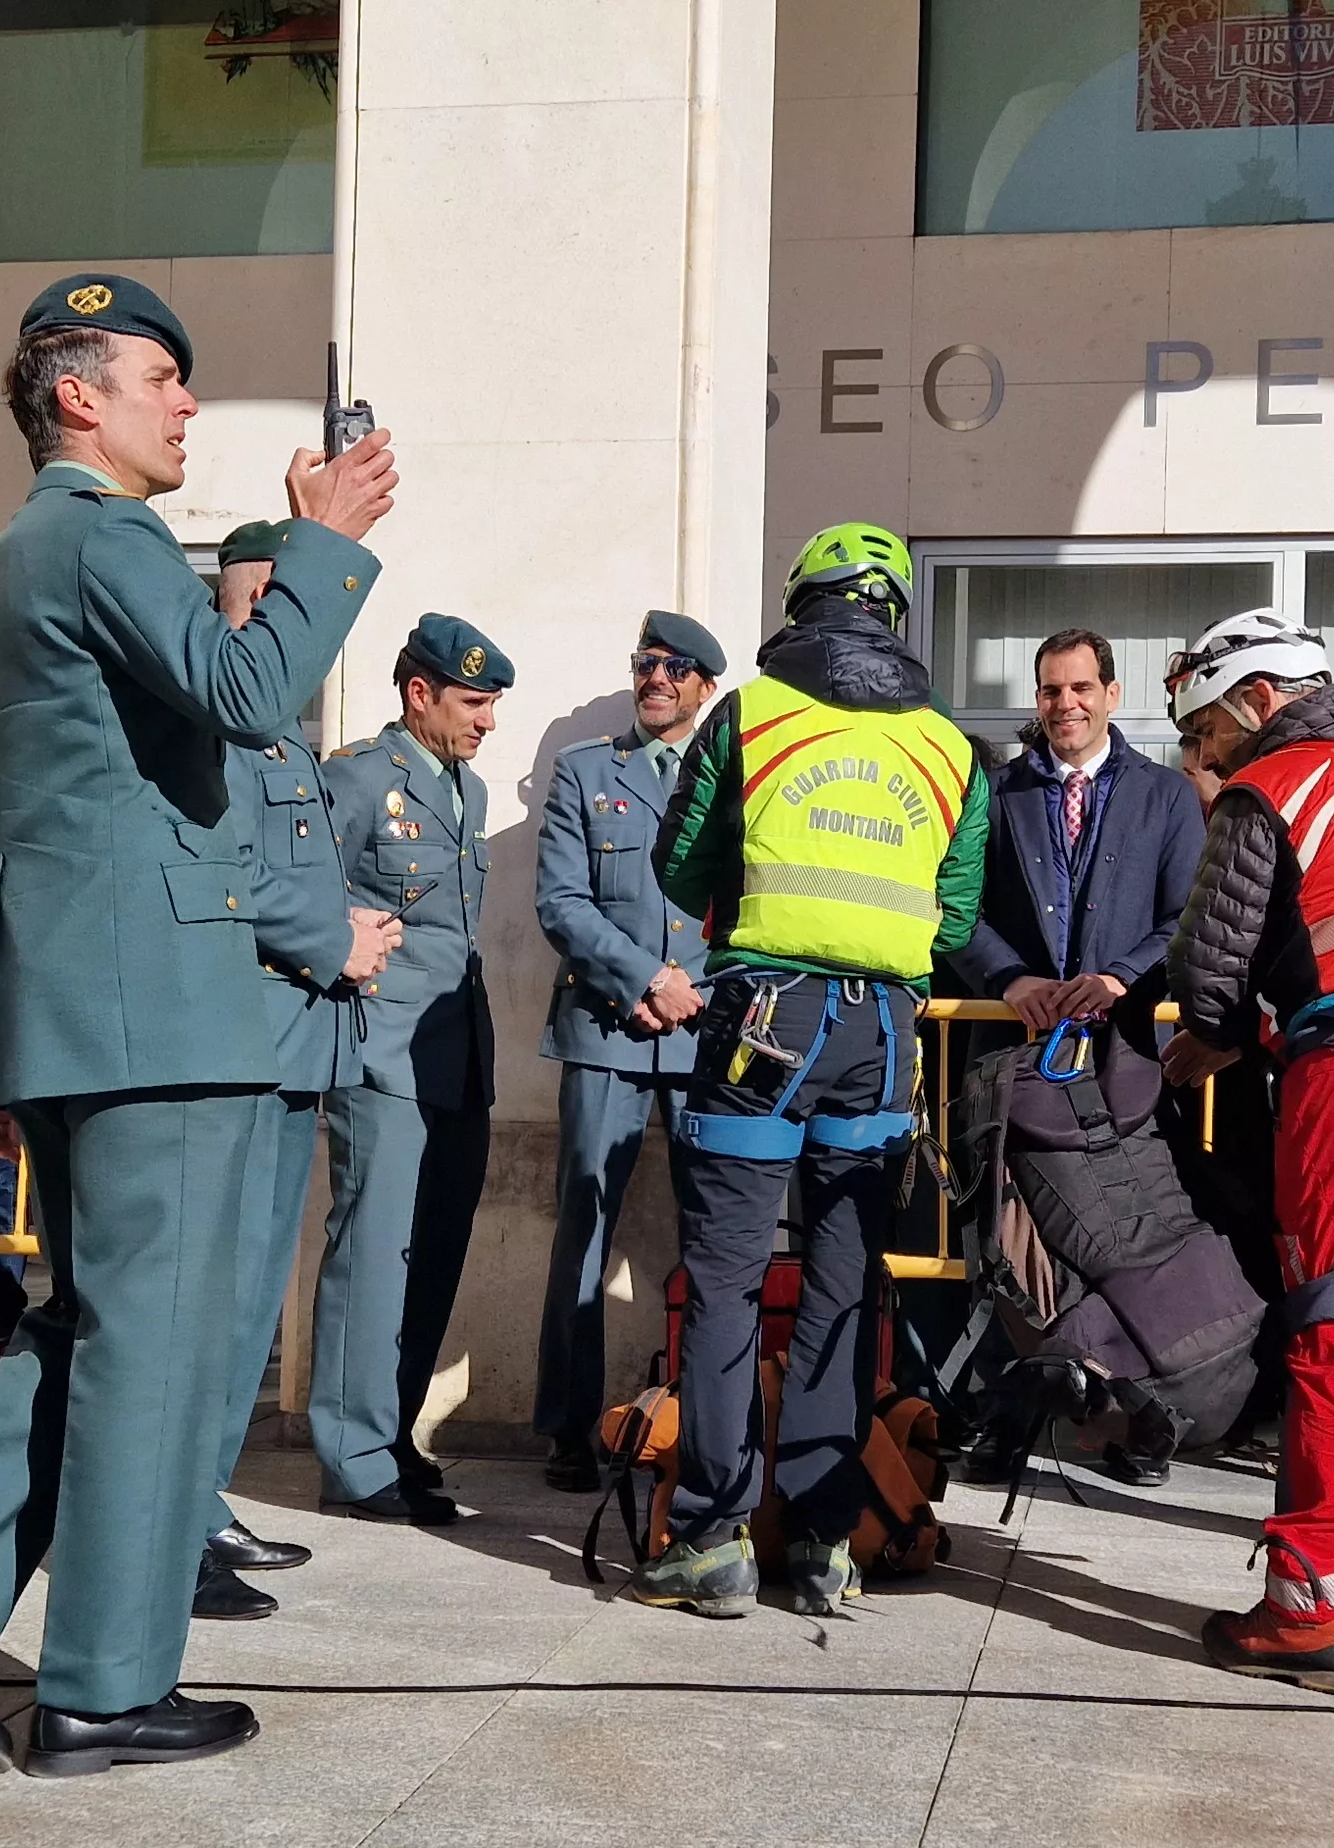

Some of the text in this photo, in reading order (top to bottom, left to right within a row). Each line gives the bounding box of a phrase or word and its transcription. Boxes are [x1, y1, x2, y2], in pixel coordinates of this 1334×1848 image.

[1230, 43, 1286, 66] LUIS
[767, 342, 1005, 434] EO
[781, 757, 929, 830] GUARDIA CIVIL
[809, 807, 904, 847] MONTAÑA
